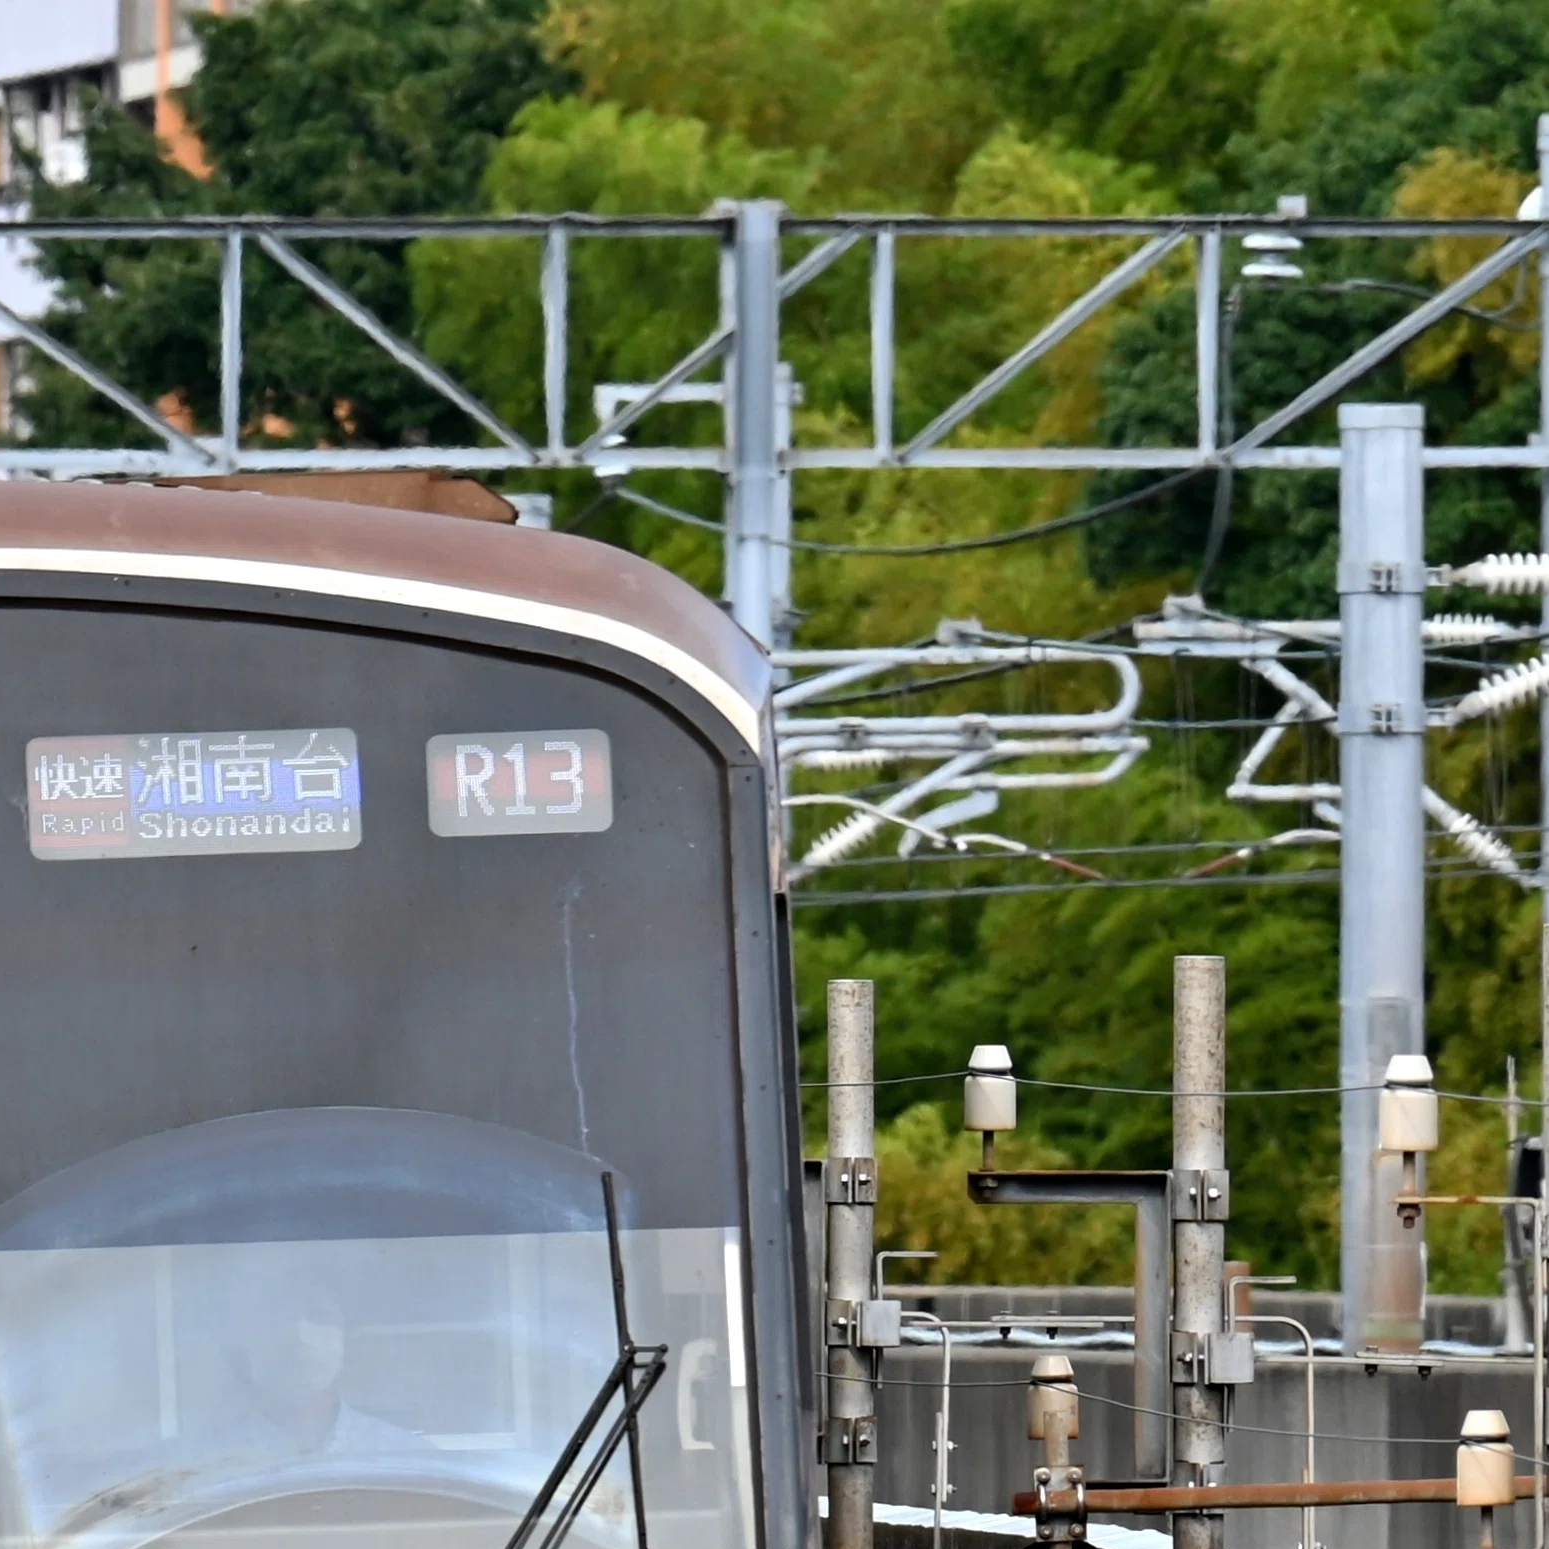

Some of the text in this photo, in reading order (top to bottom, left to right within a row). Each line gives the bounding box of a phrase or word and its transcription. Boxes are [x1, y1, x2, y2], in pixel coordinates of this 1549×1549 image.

[34, 732, 350, 806] 快速 湘南台
[454, 740, 584, 817] R13
[41, 807, 351, 839] Rapid Shonandai
